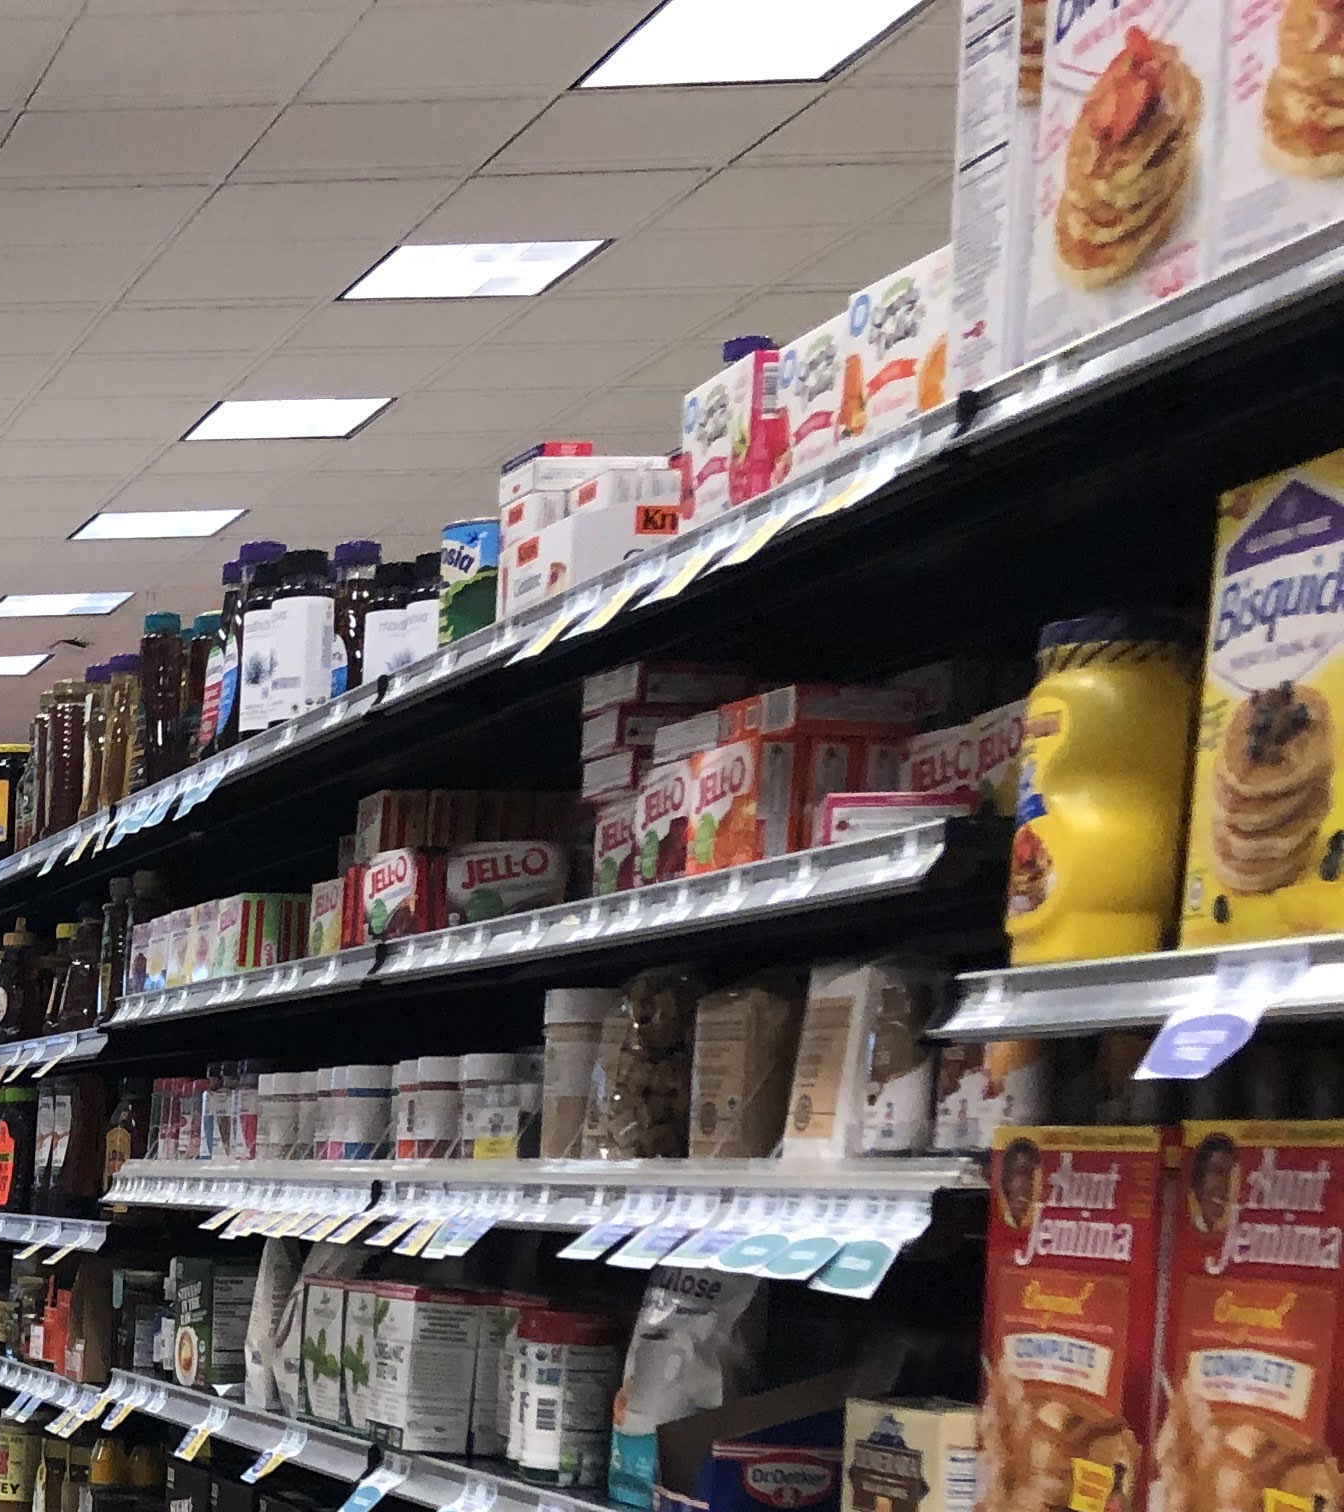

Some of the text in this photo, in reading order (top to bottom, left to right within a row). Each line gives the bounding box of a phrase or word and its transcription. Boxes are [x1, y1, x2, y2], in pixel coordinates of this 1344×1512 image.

[695, 755, 746, 815] JELL-O
[368, 854, 408, 900] JELL-O
[462, 848, 549, 890] JELL-O
[1015, 1200, 1132, 1266] Jemima
[1205, 1200, 1342, 1274] Jemima
